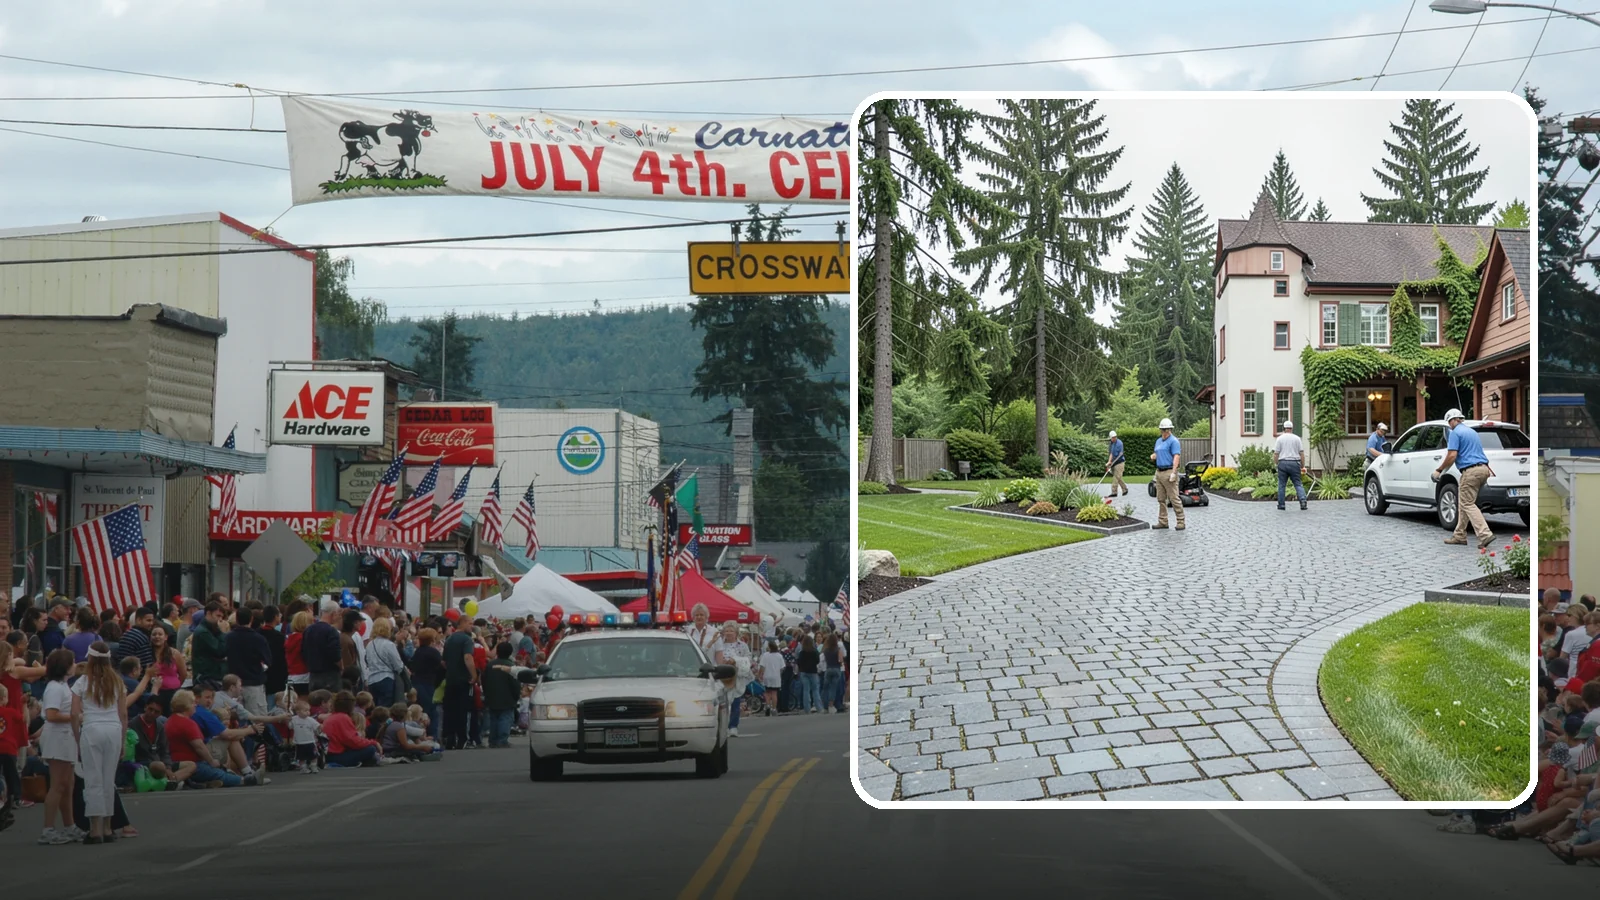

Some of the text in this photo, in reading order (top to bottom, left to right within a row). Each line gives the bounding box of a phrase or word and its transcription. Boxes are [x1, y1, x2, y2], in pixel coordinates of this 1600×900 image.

[481, 141, 604, 192] JULY
[632, 150, 746, 197] 4th.
[696, 254, 850, 280] CROSSWA
[282, 380, 373, 420] ACE
[406, 409, 452, 422] CEDAR
[283, 421, 370, 436] Hardware
[416, 428, 477, 447] Coca-Cola
[354, 467, 386, 480] Simpl
[95, 485, 124, 495] Vincent
[126, 486, 136, 495] de
[137, 486, 155, 495] Paul
[212, 516, 331, 535] HARDARE
[688, 526, 741, 535] CRNATION
[699, 535, 730, 543] GLASS
